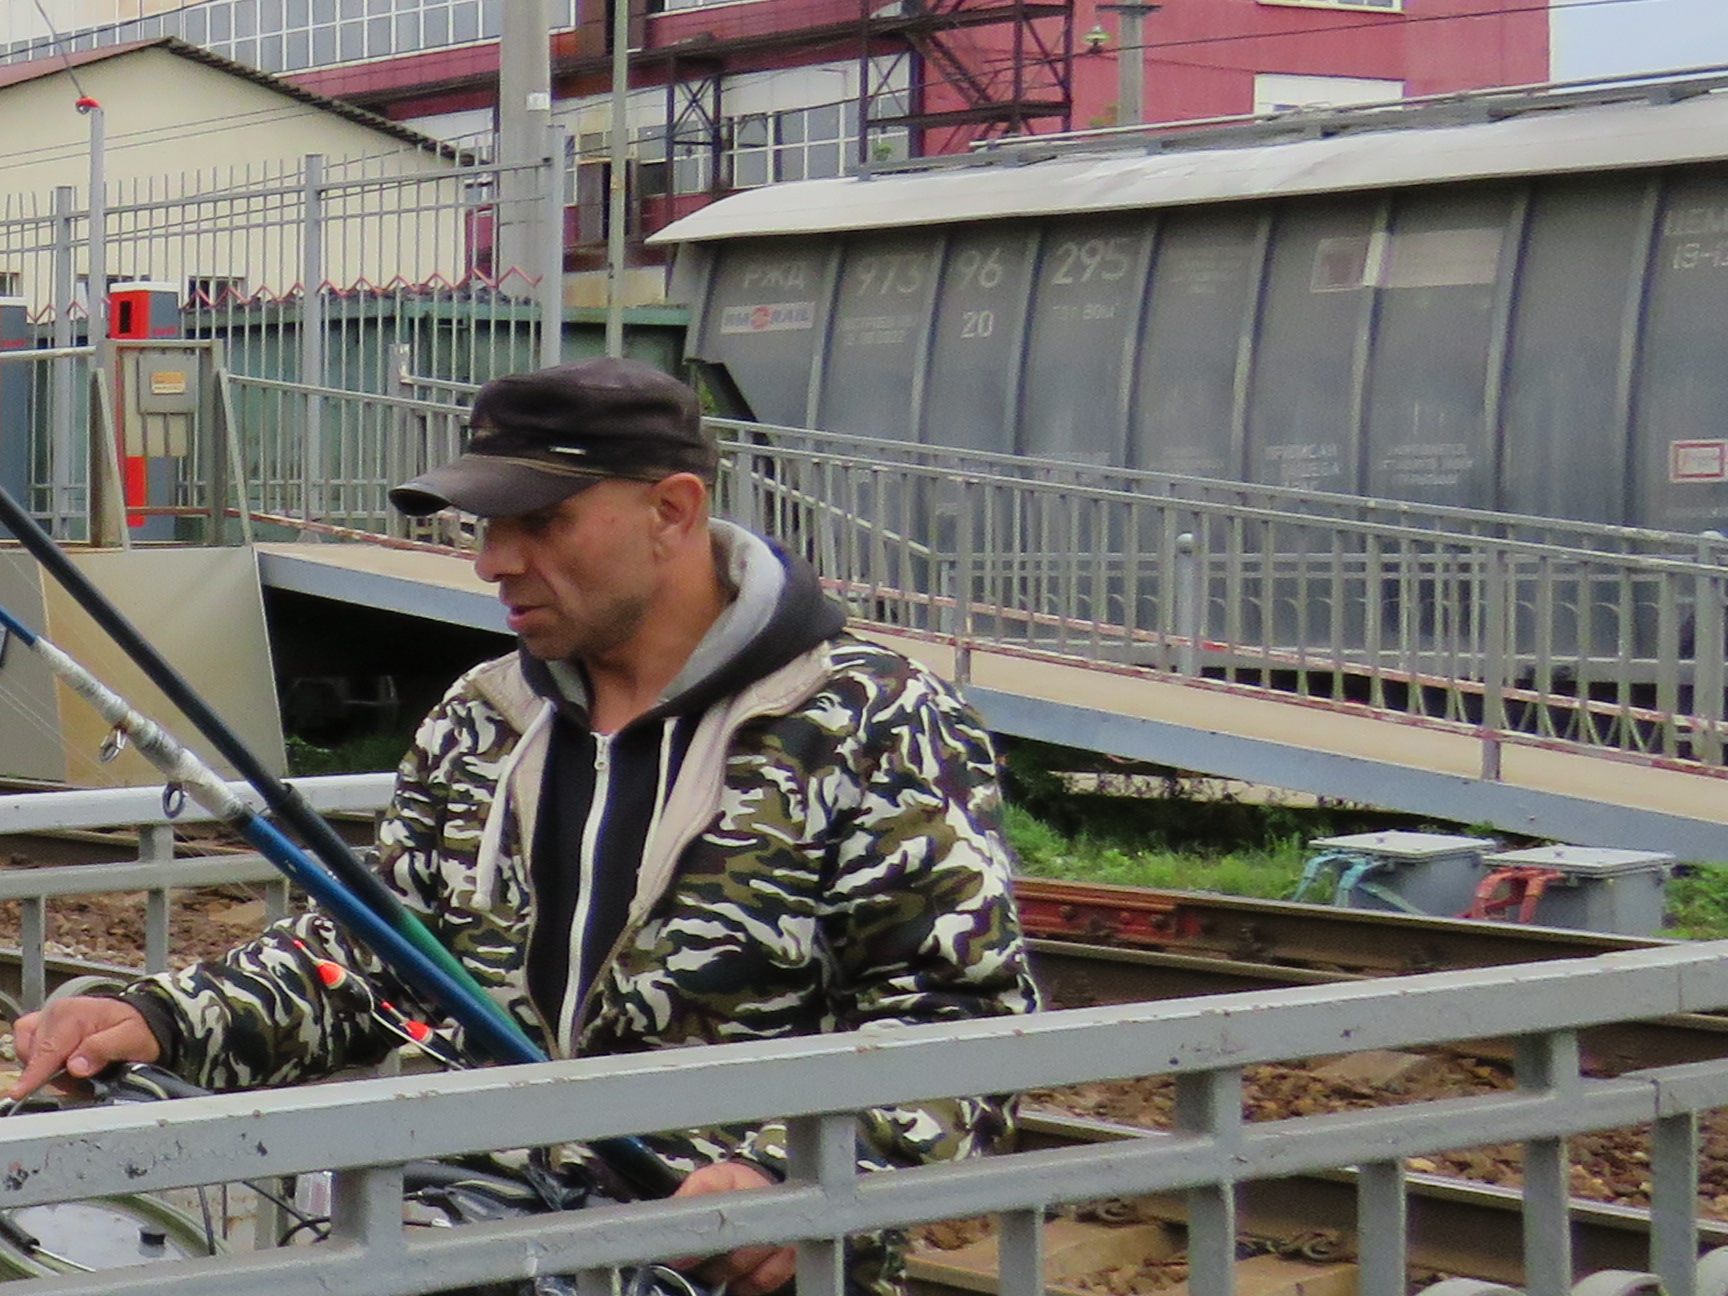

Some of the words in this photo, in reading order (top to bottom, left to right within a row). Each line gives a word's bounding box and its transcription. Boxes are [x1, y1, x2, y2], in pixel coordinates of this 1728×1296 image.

[956, 247, 1004, 290] 96
[1050, 237, 1131, 286] 295
[960, 310, 995, 340] 20
